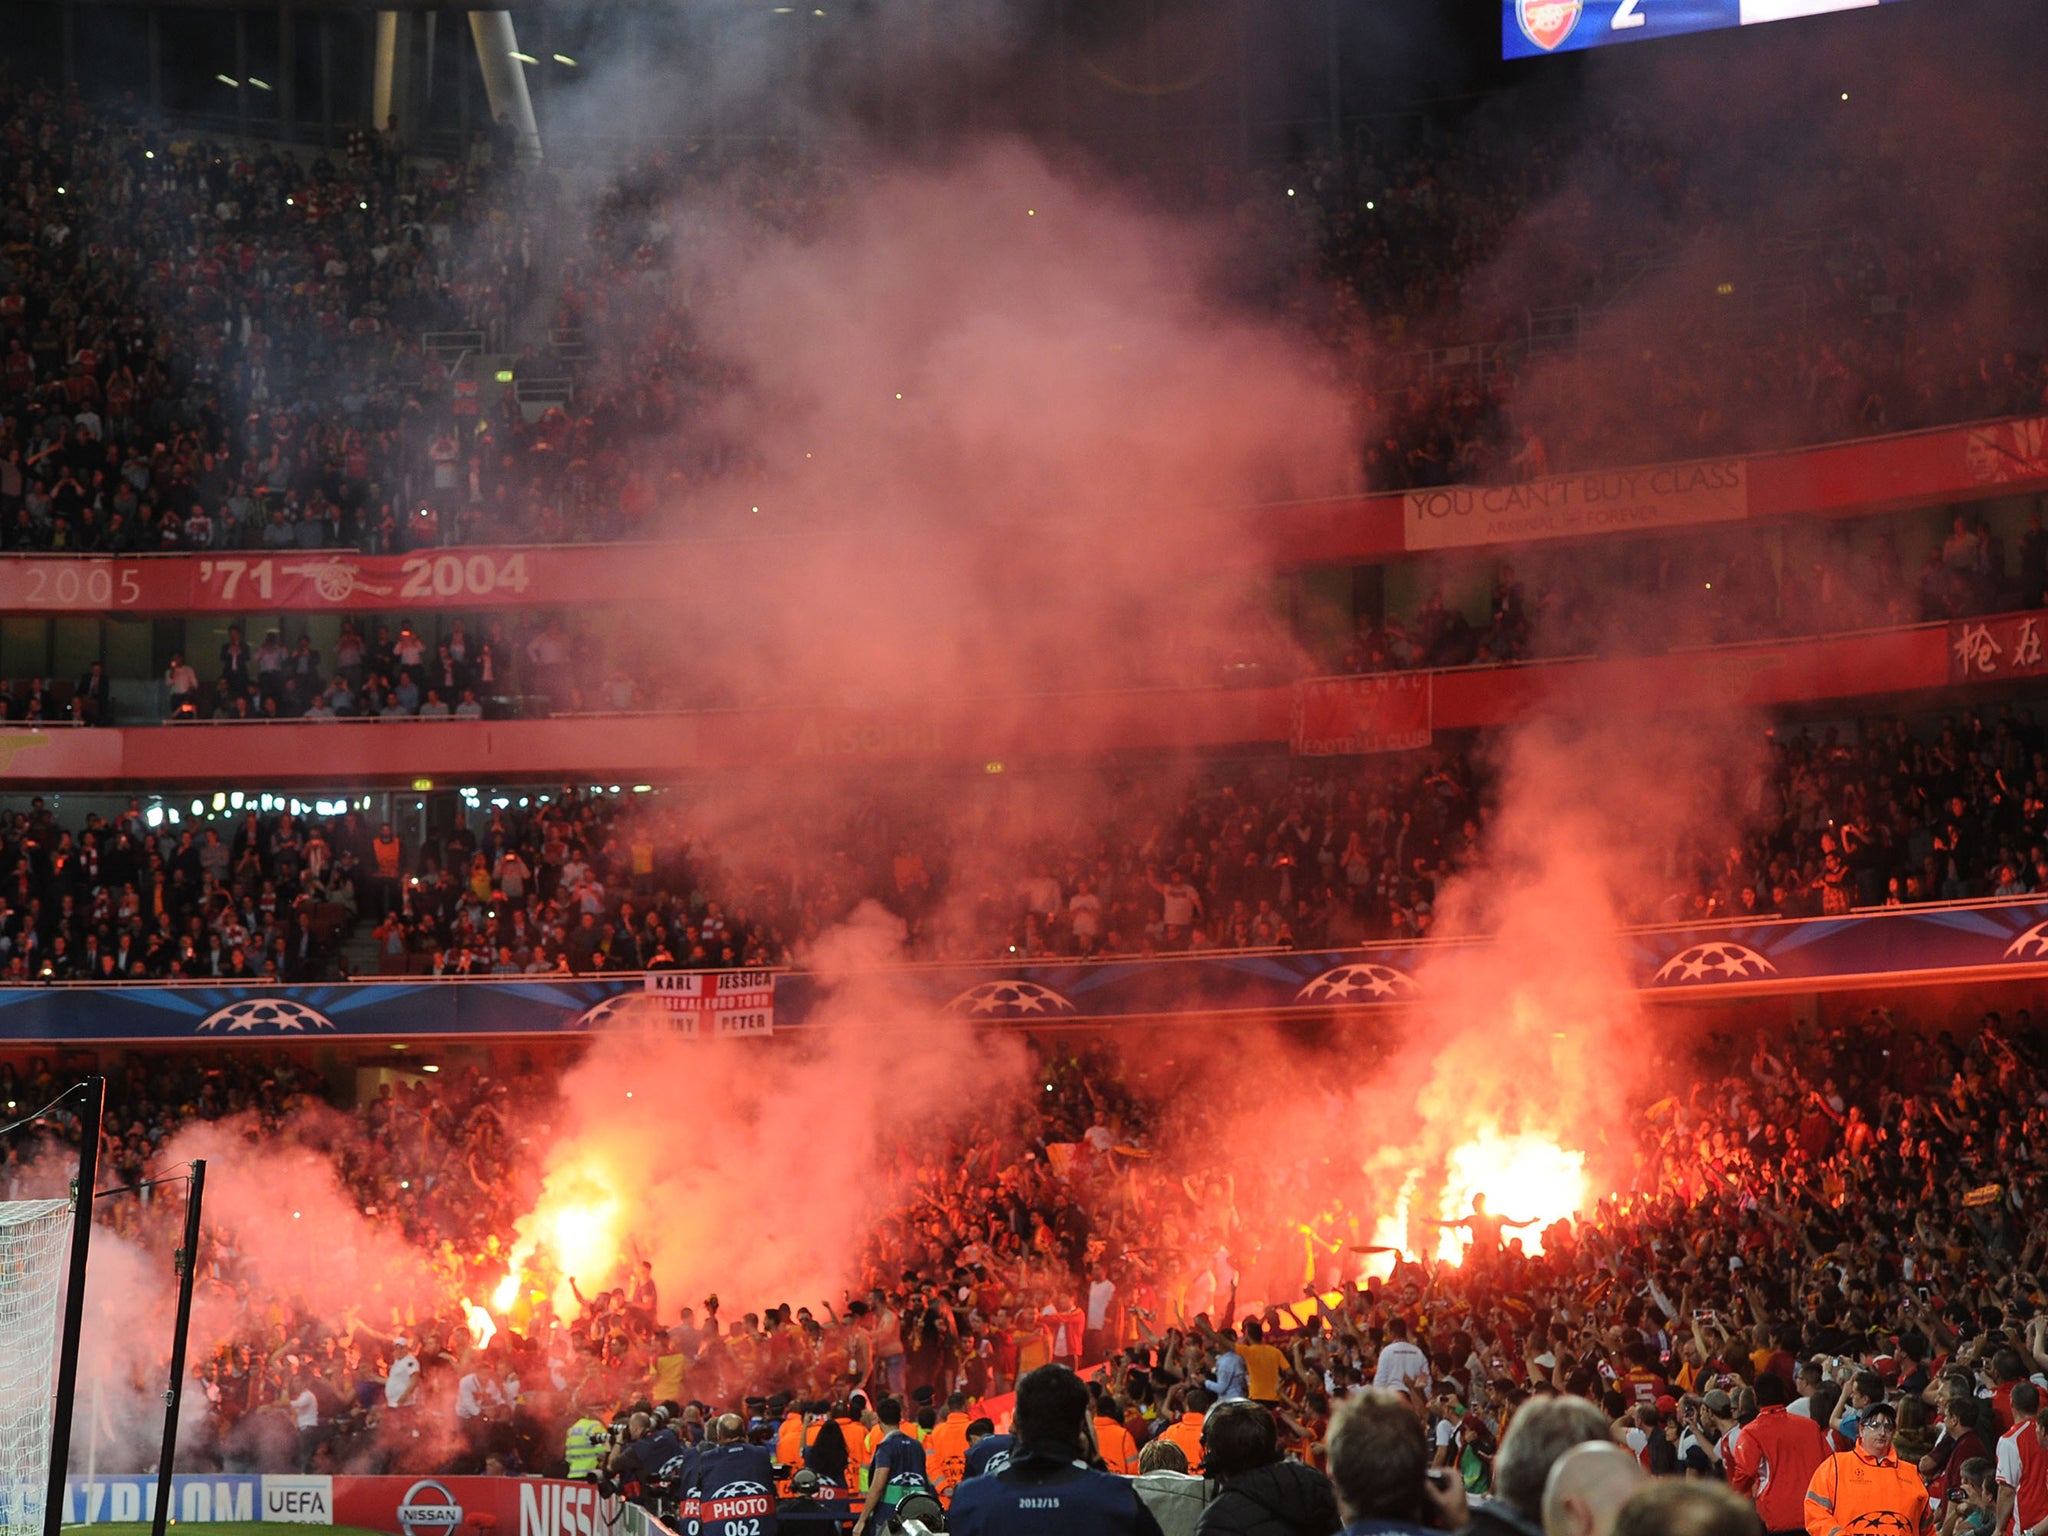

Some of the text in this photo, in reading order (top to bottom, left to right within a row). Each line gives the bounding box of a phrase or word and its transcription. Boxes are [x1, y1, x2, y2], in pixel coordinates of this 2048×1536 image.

[1411, 463, 1739, 520] YOU CAN'T BUY CLASS
[1586, 505, 1658, 526] FOREVER
[25, 568, 140, 604] 2005
[401, 554, 531, 598] 2004
[1309, 675, 1421, 696] ARSENAL
[1303, 734, 1379, 754] FOOTBALL
[656, 972, 772, 990] KARL JESSICA
[652, 993, 769, 1011] ARSENAL EURO TOUR
[722, 1014, 765, 1031] PETER
[269, 1490, 326, 1514] UEFA
[403, 1509, 456, 1521] NISSAN
[713, 1498, 767, 1518] PHOTO
[1019, 1498, 1060, 1509] 2012/15
[724, 1518, 760, 1536] 062
